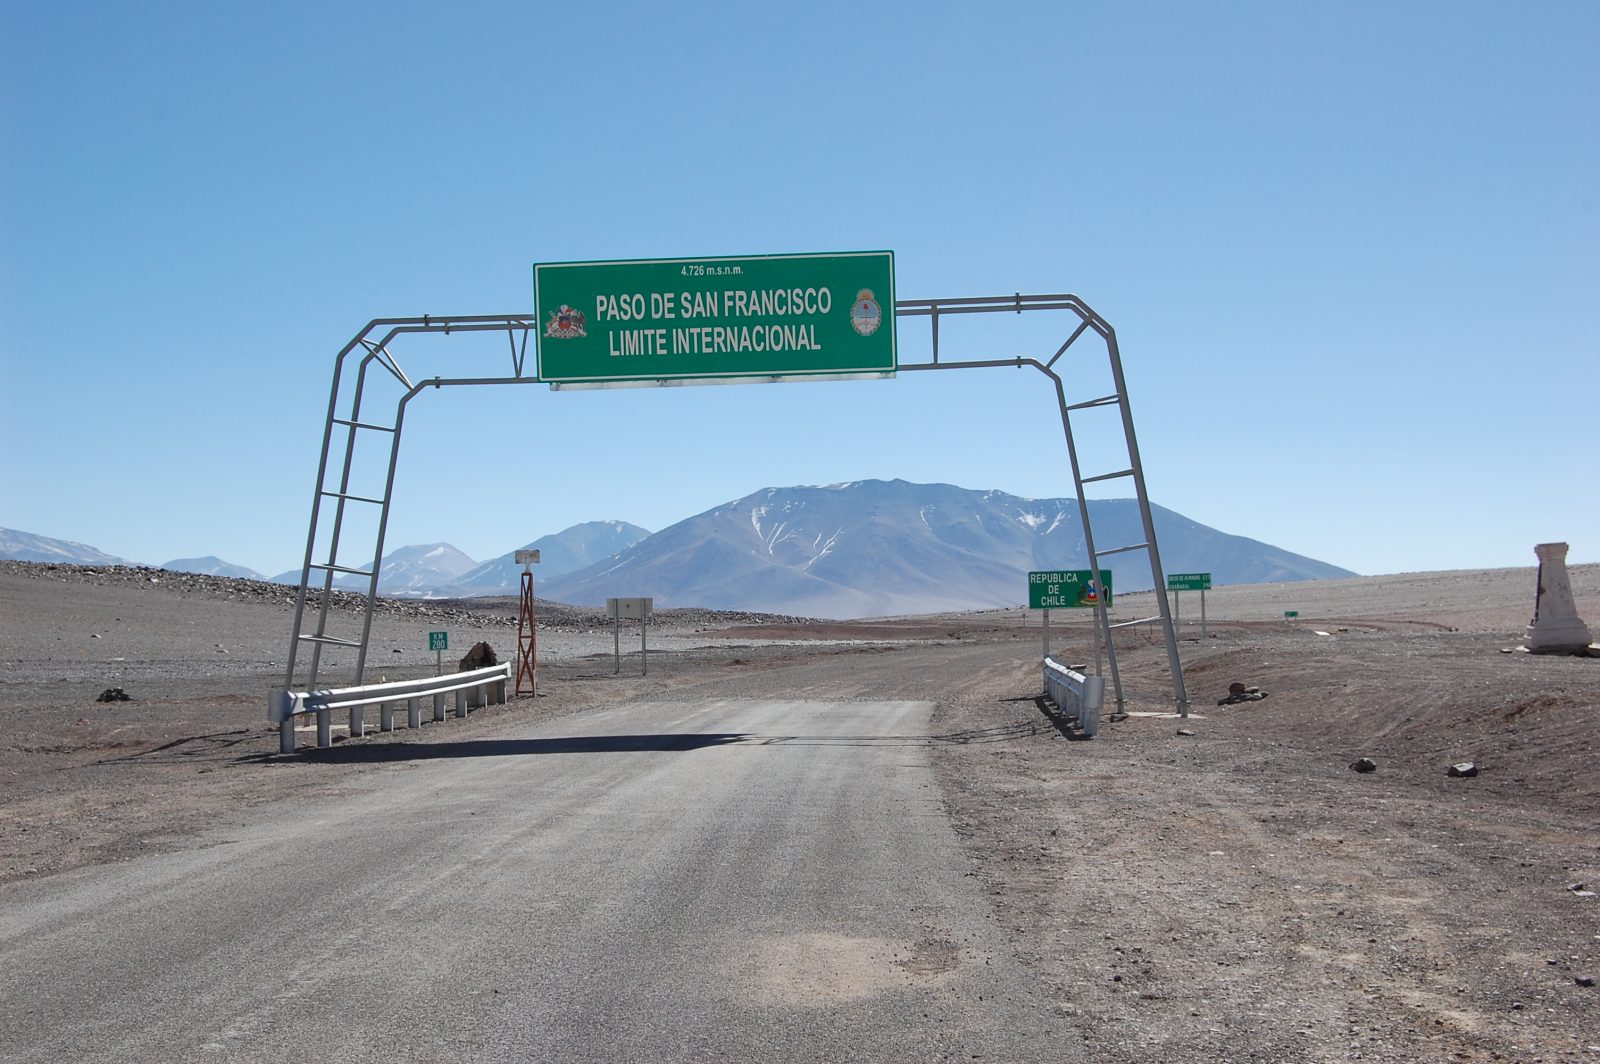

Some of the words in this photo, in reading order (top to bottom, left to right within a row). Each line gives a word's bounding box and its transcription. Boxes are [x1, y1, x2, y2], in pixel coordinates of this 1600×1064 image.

[681, 265, 705, 277] 4.726
[706, 264, 744, 276] m.s.n.m.
[596, 293, 646, 321] PASO
[651, 292, 676, 319] DE
[680, 290, 719, 318] SAN
[724, 286, 832, 317] FRANCISCO
[609, 328, 667, 357] LIMITE
[672, 324, 821, 354] INTERNACIONAL
[1030, 573, 1078, 584] REPUBLICA
[1048, 584, 1060, 594] DE
[1041, 595, 1066, 606] CHILE
[432, 640, 445, 649] 280
